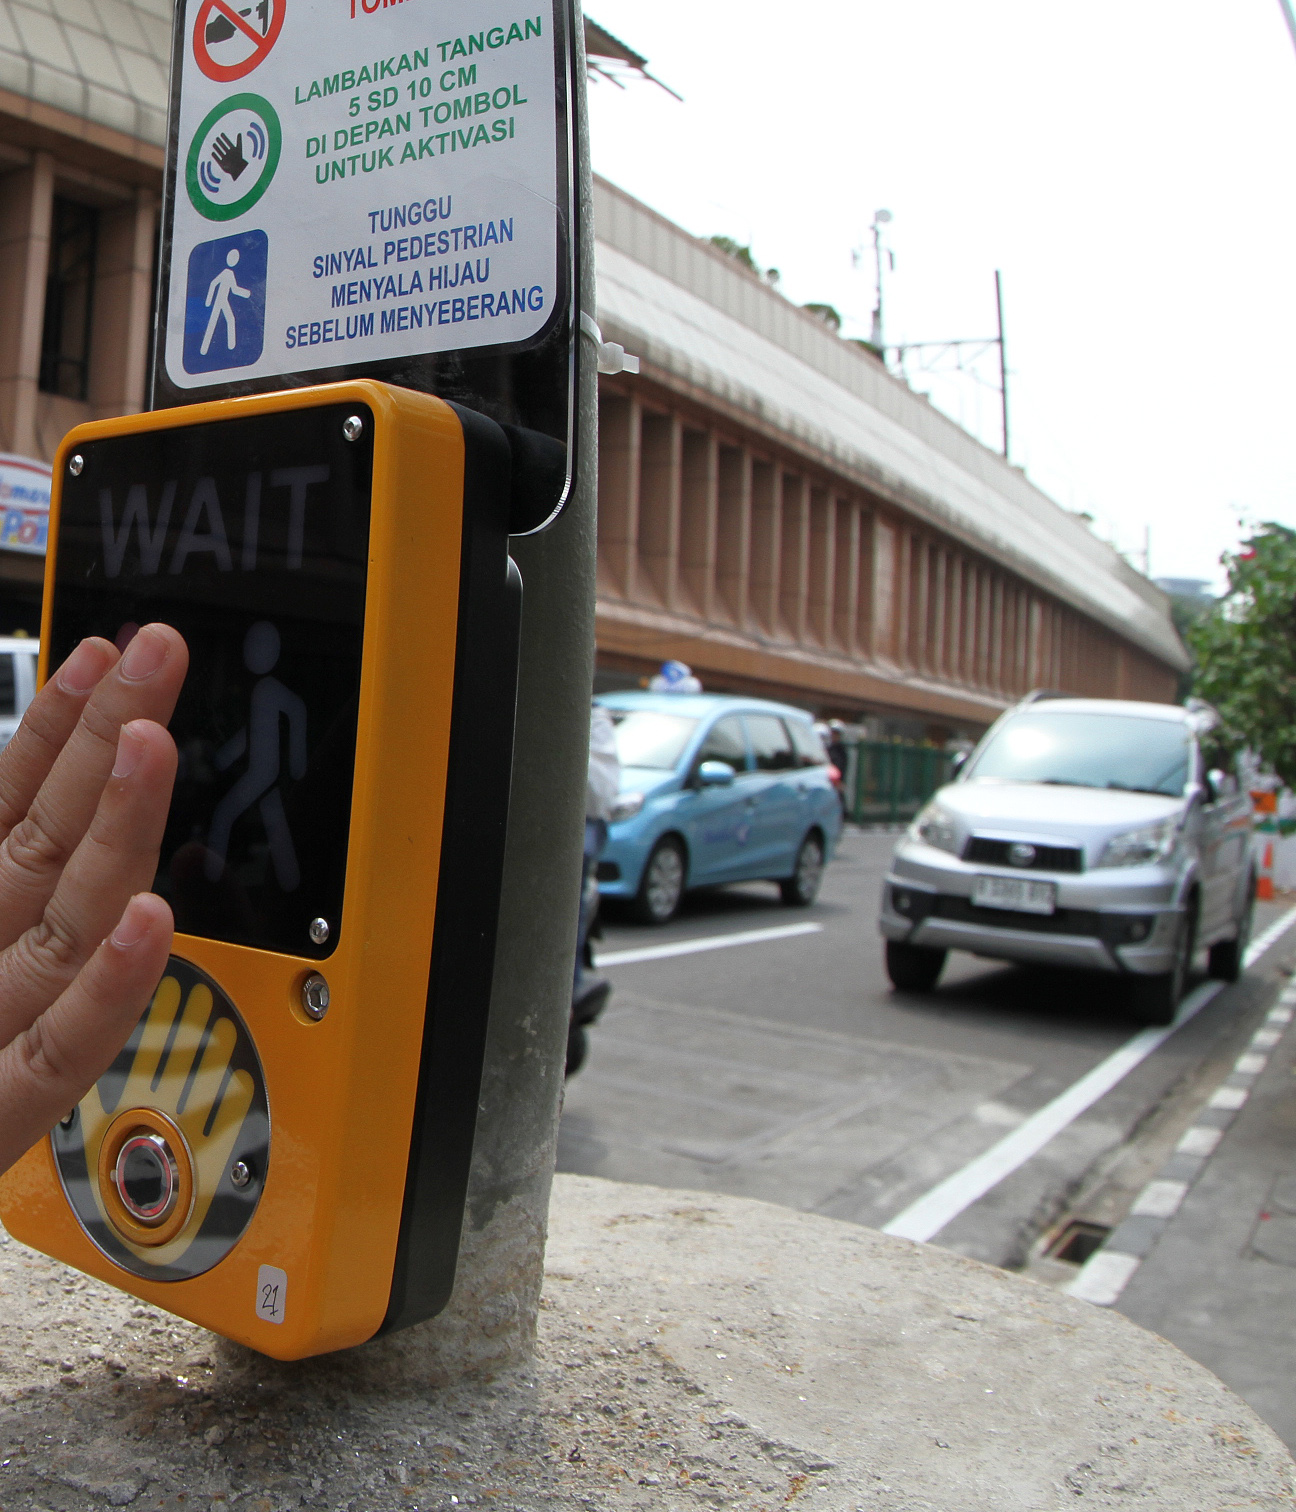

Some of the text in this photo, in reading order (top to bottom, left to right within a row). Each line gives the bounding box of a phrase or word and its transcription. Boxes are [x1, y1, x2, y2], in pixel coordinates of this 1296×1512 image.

[294, 16, 542, 104] LAMBAIKAN TANGAN
[349, 63, 477, 117] 5 SD 10 CM
[306, 83, 529, 158] DI DEPAN TOMBOL
[315, 116, 515, 184] UNTUK AKTIVASI
[368, 195, 452, 234] TUNGGU
[312, 217, 514, 279] SINYAL PEDESTRIAN
[331, 257, 491, 308] MENYALA HIJAU
[285, 284, 545, 349] SEBELUM MENYEBERANG
[98, 464, 330, 578] WAIT
